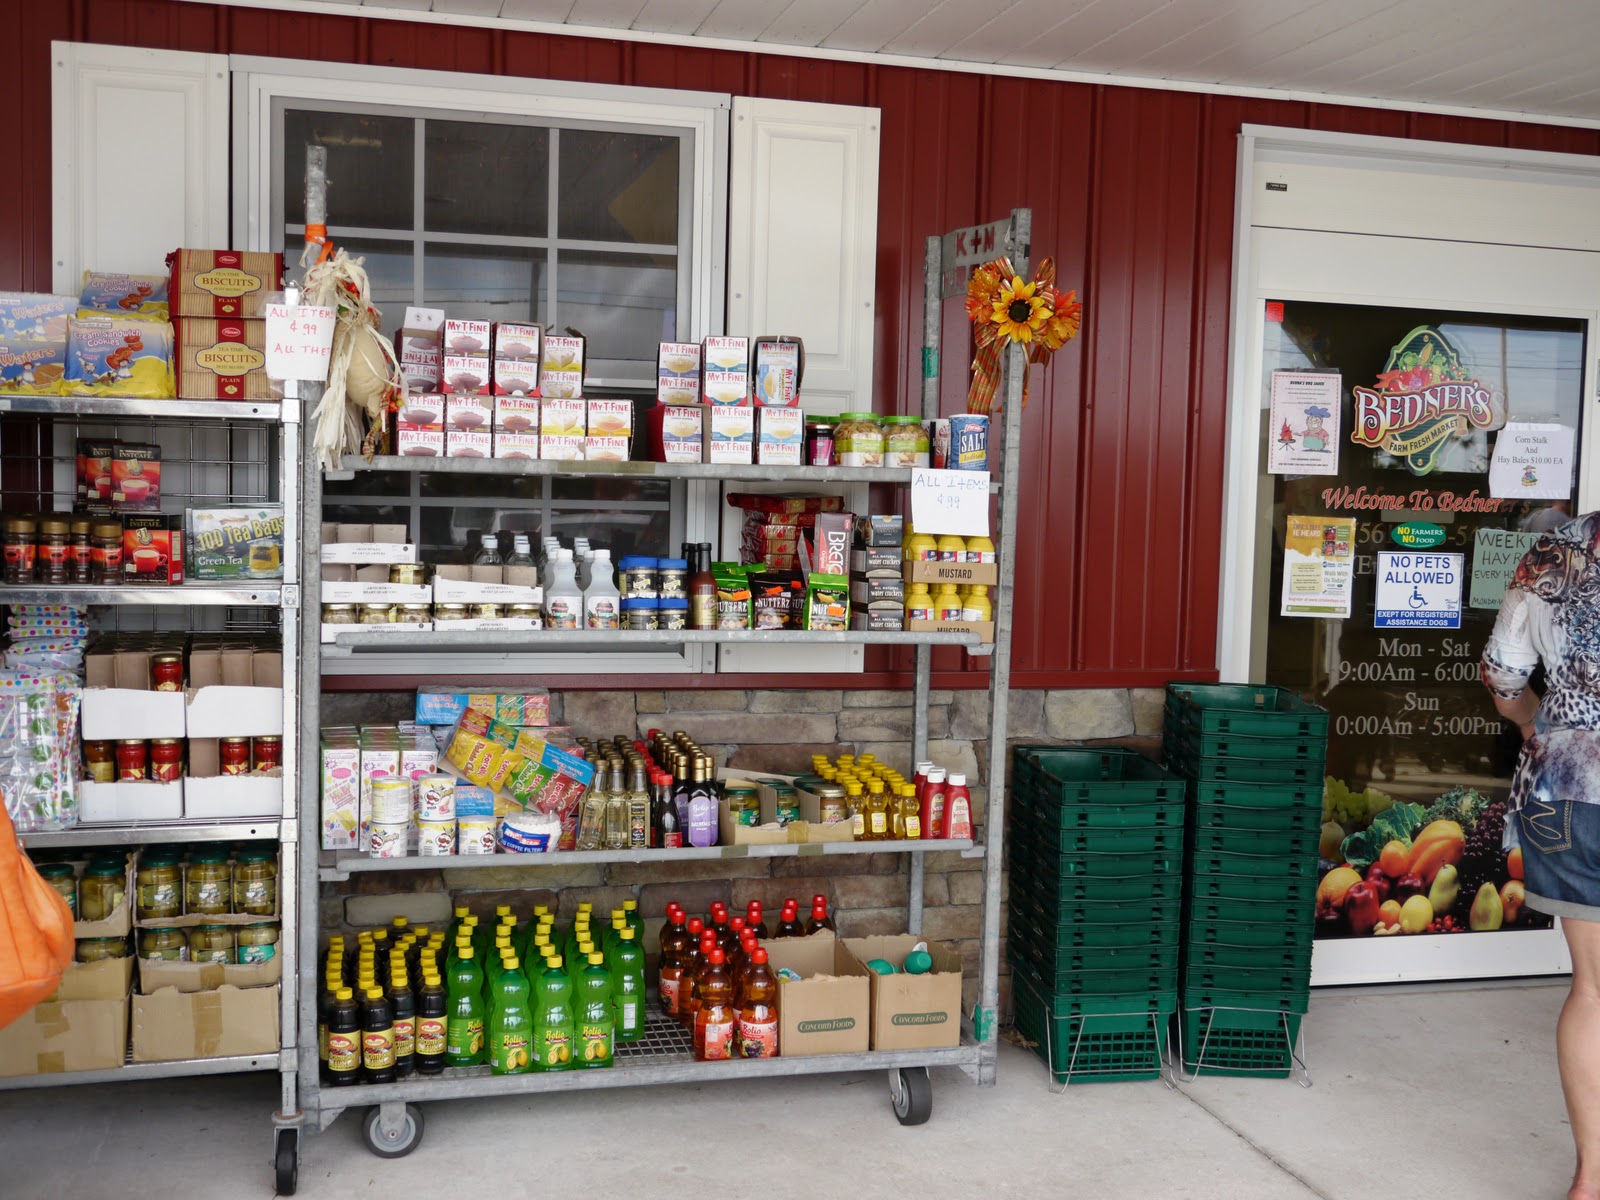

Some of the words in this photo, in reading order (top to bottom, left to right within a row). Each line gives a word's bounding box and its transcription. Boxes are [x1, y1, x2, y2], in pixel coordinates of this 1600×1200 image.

[202, 277, 254, 286] BISCUITS
[74, 331, 99, 340] Cream
[88, 338, 119, 346] Cookies
[0, 348, 55, 366] Wafers
[204, 354, 257, 363] BISCUITS
[1355, 382, 1490, 442] BEDNER'S
[1390, 442, 1408, 453] FARM
[1409, 436, 1431, 450] FRESH
[1431, 418, 1459, 439] MARKET
[962, 433, 984, 452] SALT
[1498, 456, 1510, 464] Hay
[915, 473, 941, 487] ALL
[1322, 486, 1404, 510] Welcome
[1409, 490, 1433, 511] To
[197, 529, 223, 550] 100
[223, 525, 251, 544] Tea
[251, 516, 284, 538] Bags
[1402, 535, 1415, 543] NO
[1477, 532, 1525, 548] WEEK
[198, 557, 225, 565] Green
[227, 556, 242, 564] Tea
[1391, 556, 1410, 568] NO
[1416, 557, 1450, 569] PETS
[1482, 551, 1511, 565] HAY
[939, 568, 972, 579] MUSTARD
[1385, 572, 1453, 584] ALLOWED
[1475, 570, 1501, 579] EVERY
[758, 598, 790, 608] NUTTERZ
[1378, 638, 1422, 657] Mon
[1441, 638, 1470, 657] Sat
[1339, 661, 1415, 681] 9:00Am
[1404, 692, 1440, 711] Sun
[1432, 716, 1502, 736] 5:00Pm
[506, 842, 523, 851] COFFEE
[832, 1020, 853, 1028] FOODS
[894, 1015, 925, 1023] CONCORD
